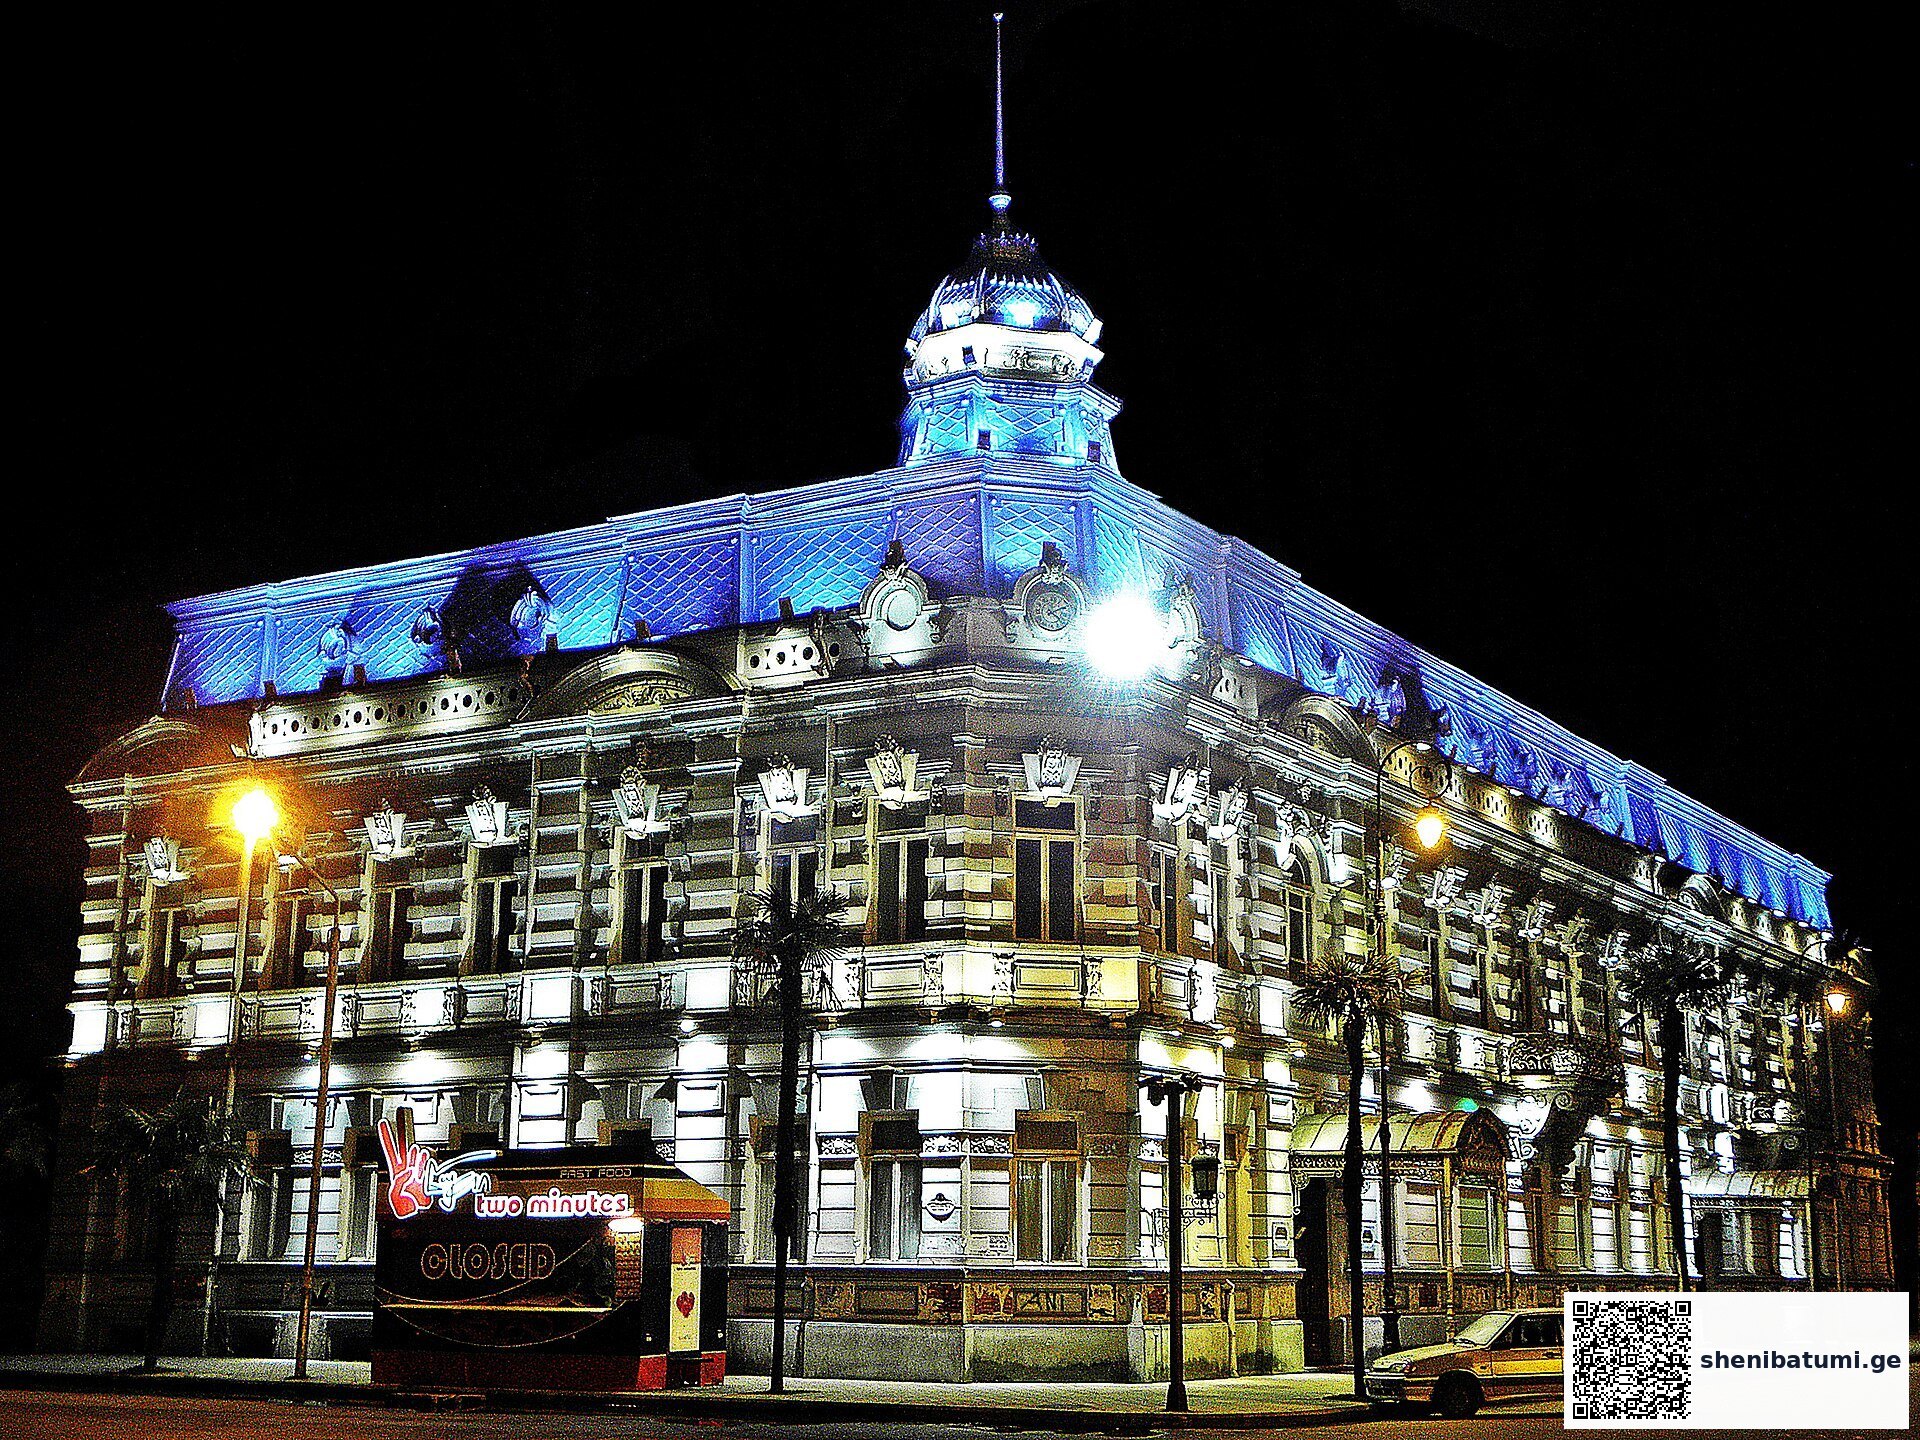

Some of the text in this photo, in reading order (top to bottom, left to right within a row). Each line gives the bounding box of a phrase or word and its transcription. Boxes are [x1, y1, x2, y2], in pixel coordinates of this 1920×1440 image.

[560, 1167, 632, 1179] FAST FOOD
[476, 1190, 627, 1214] two minutes
[420, 1242, 556, 1280] CLOSED
